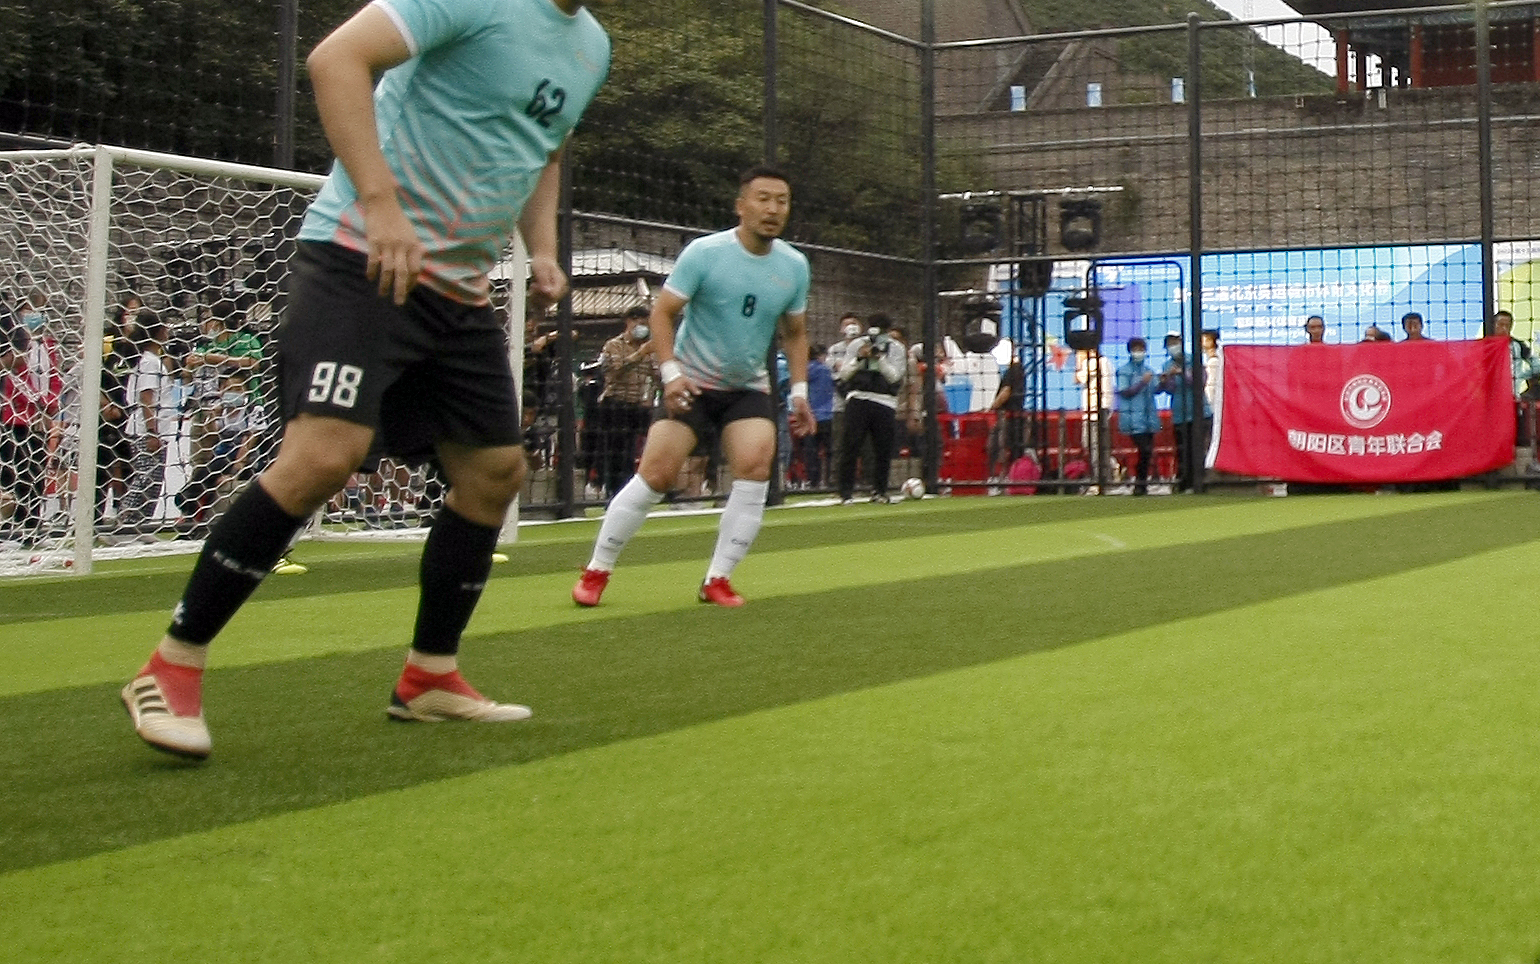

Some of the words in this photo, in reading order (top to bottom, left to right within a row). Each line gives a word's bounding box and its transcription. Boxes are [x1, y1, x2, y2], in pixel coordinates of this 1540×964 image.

[525, 78, 566, 129] 62
[742, 293, 757, 318] 8
[308, 361, 363, 408] 98
[1287, 429, 1443, 456] 朝阳区青年联合会
